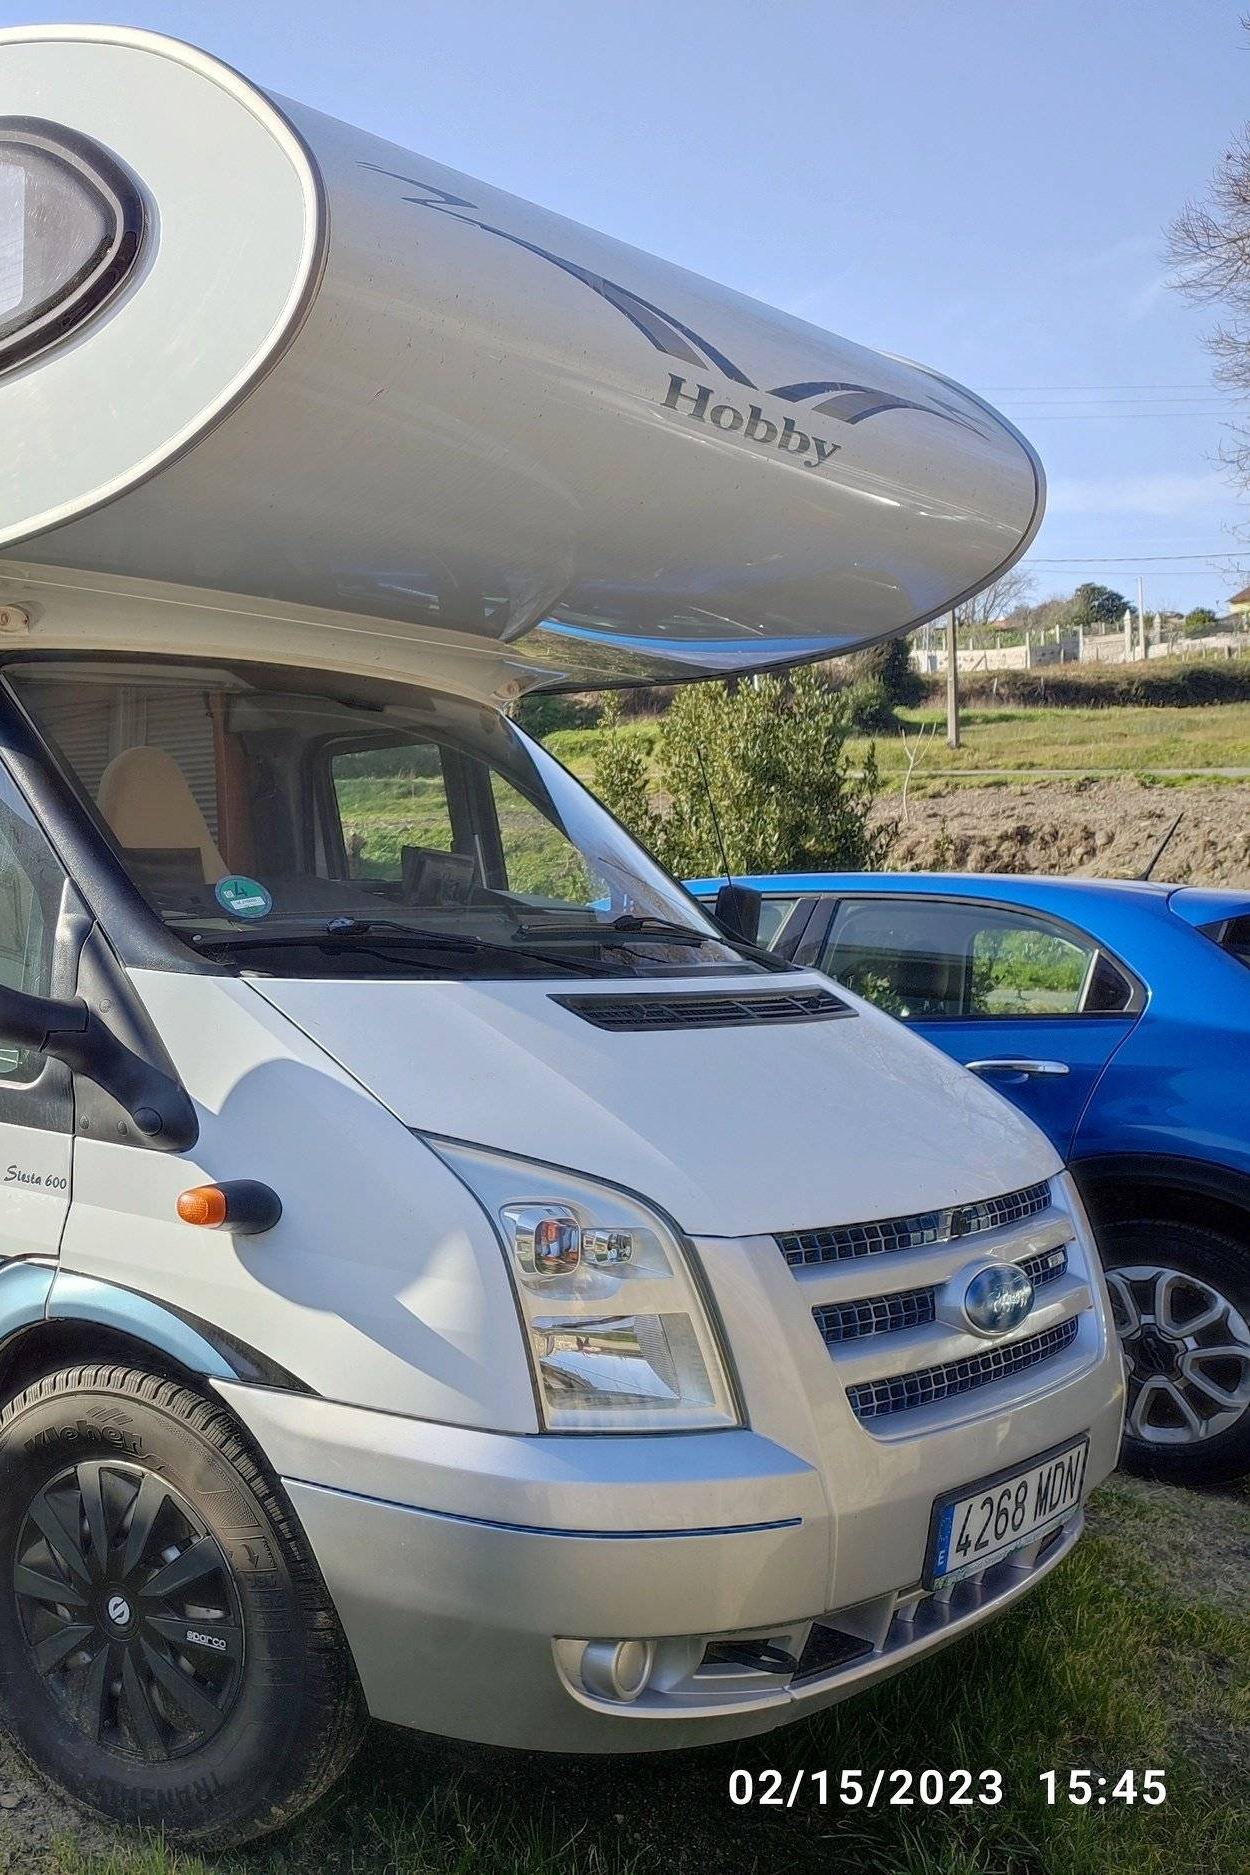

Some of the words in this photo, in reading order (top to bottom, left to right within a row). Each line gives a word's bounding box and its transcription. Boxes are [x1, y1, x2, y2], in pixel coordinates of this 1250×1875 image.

[660, 372, 842, 468] Hobby
[3, 1164, 42, 1186] Siesta
[45, 1174, 68, 1190] 600
[955, 1480, 1029, 1558] 4268
[1033, 1450, 1082, 1522] MDN
[186, 1630, 227, 1649] sparco
